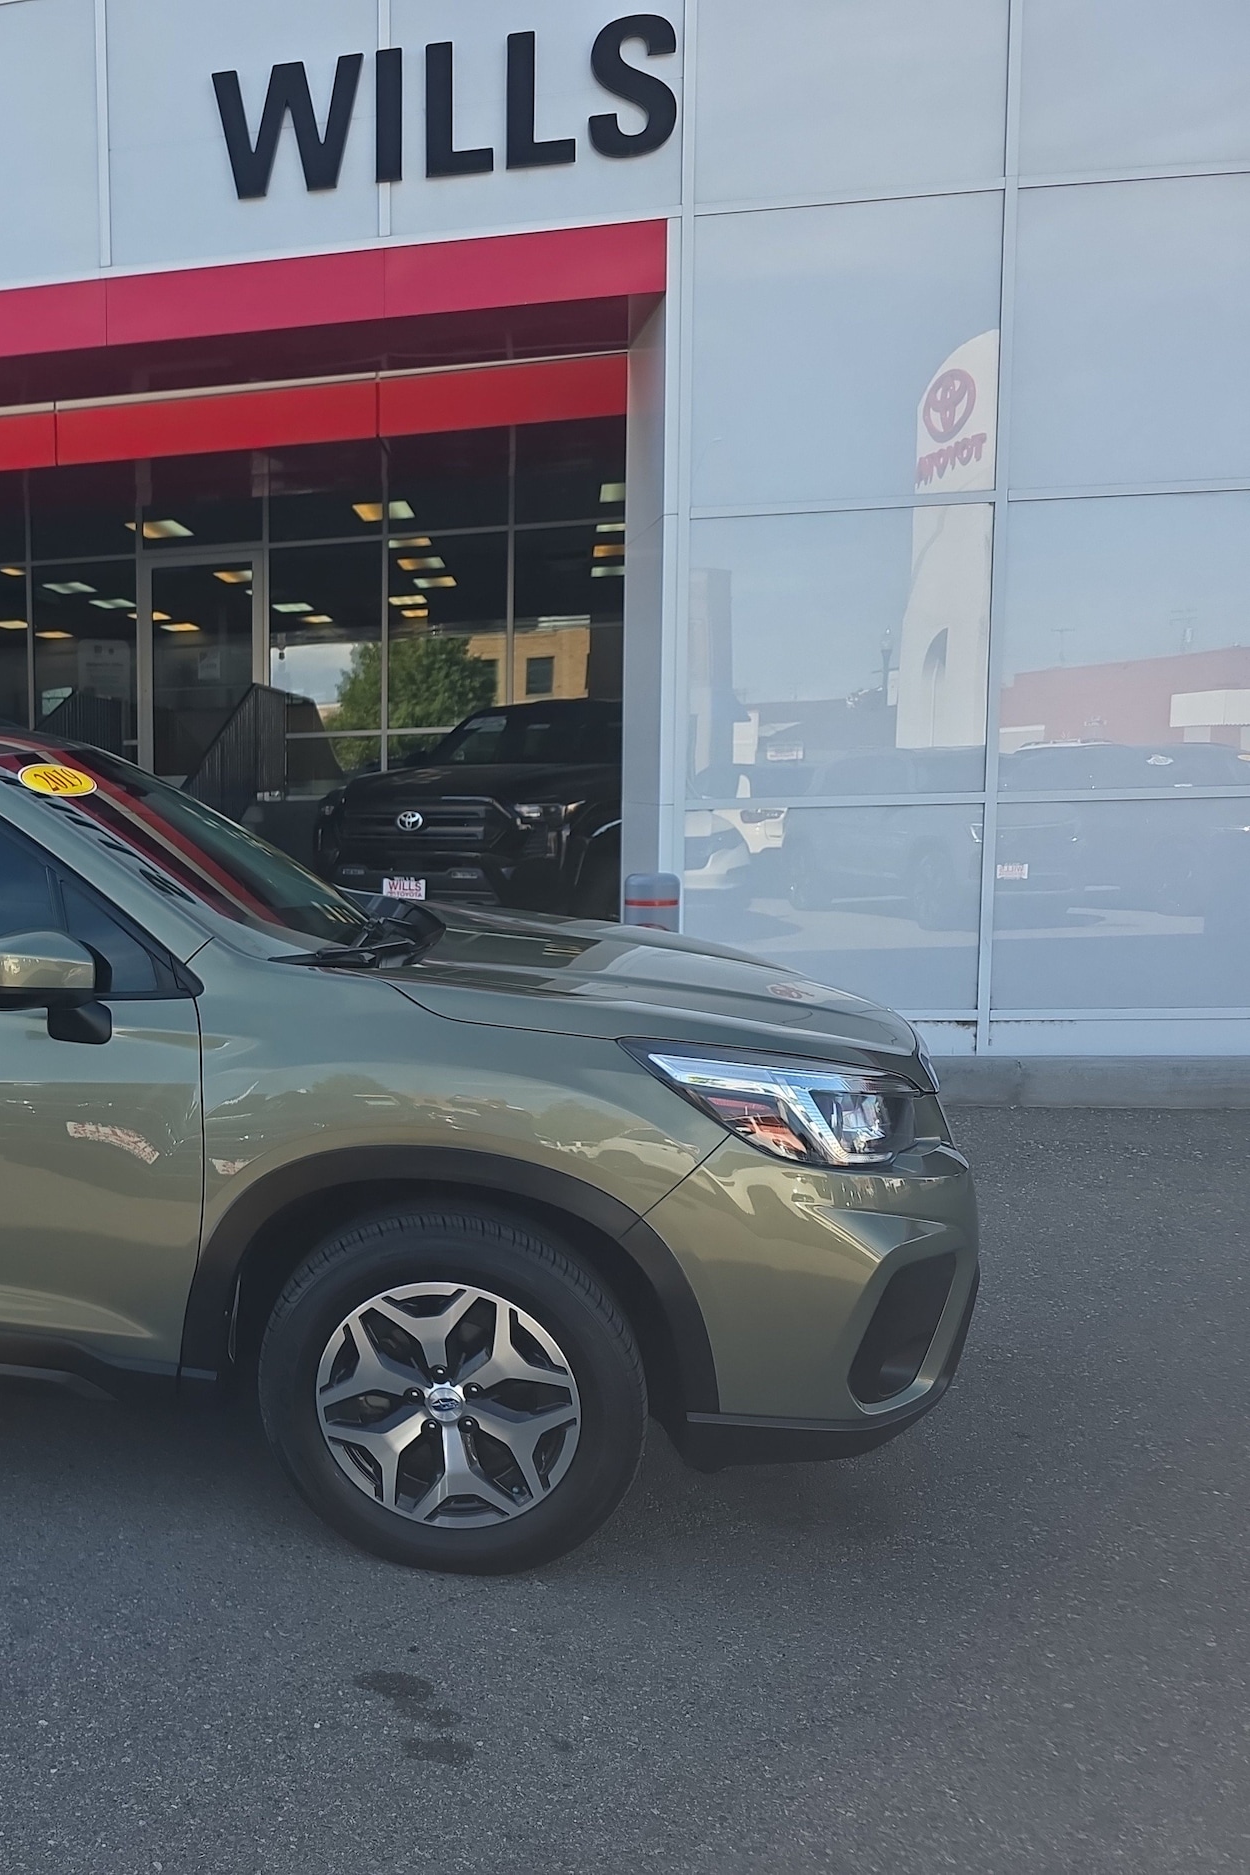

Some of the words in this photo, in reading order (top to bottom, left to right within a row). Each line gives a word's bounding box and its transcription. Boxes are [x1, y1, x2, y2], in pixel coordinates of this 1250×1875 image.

[211, 14, 677, 200] WILLS
[33, 768, 83, 792] 2019
[388, 881, 422, 892] WILLS
